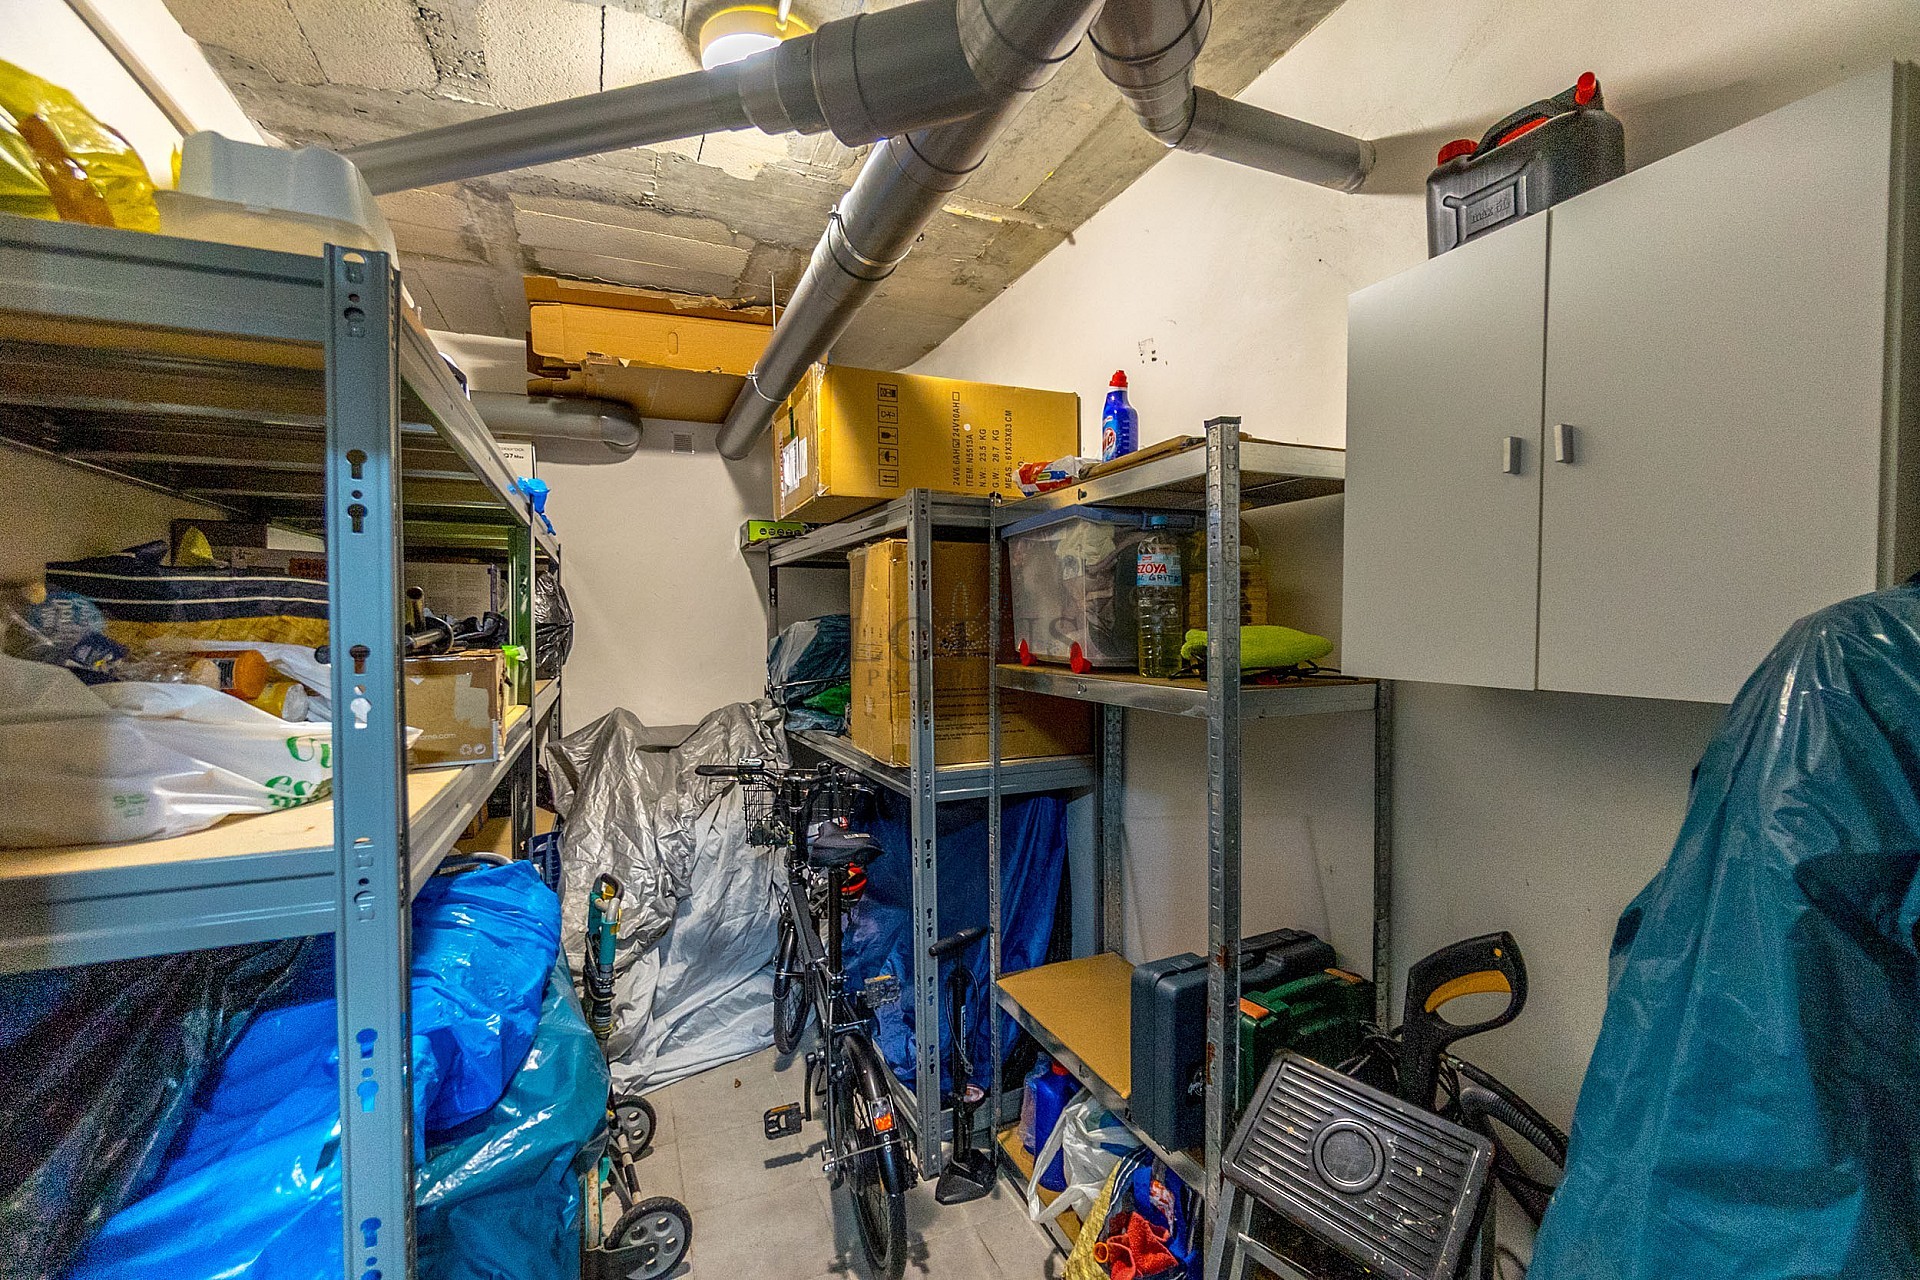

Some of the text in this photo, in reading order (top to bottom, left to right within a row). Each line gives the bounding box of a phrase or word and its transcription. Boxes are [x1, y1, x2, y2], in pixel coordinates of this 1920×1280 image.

[1005, 409, 1012, 423] CM
[979, 428, 986, 441] KG
[992, 429, 999, 441] KG
